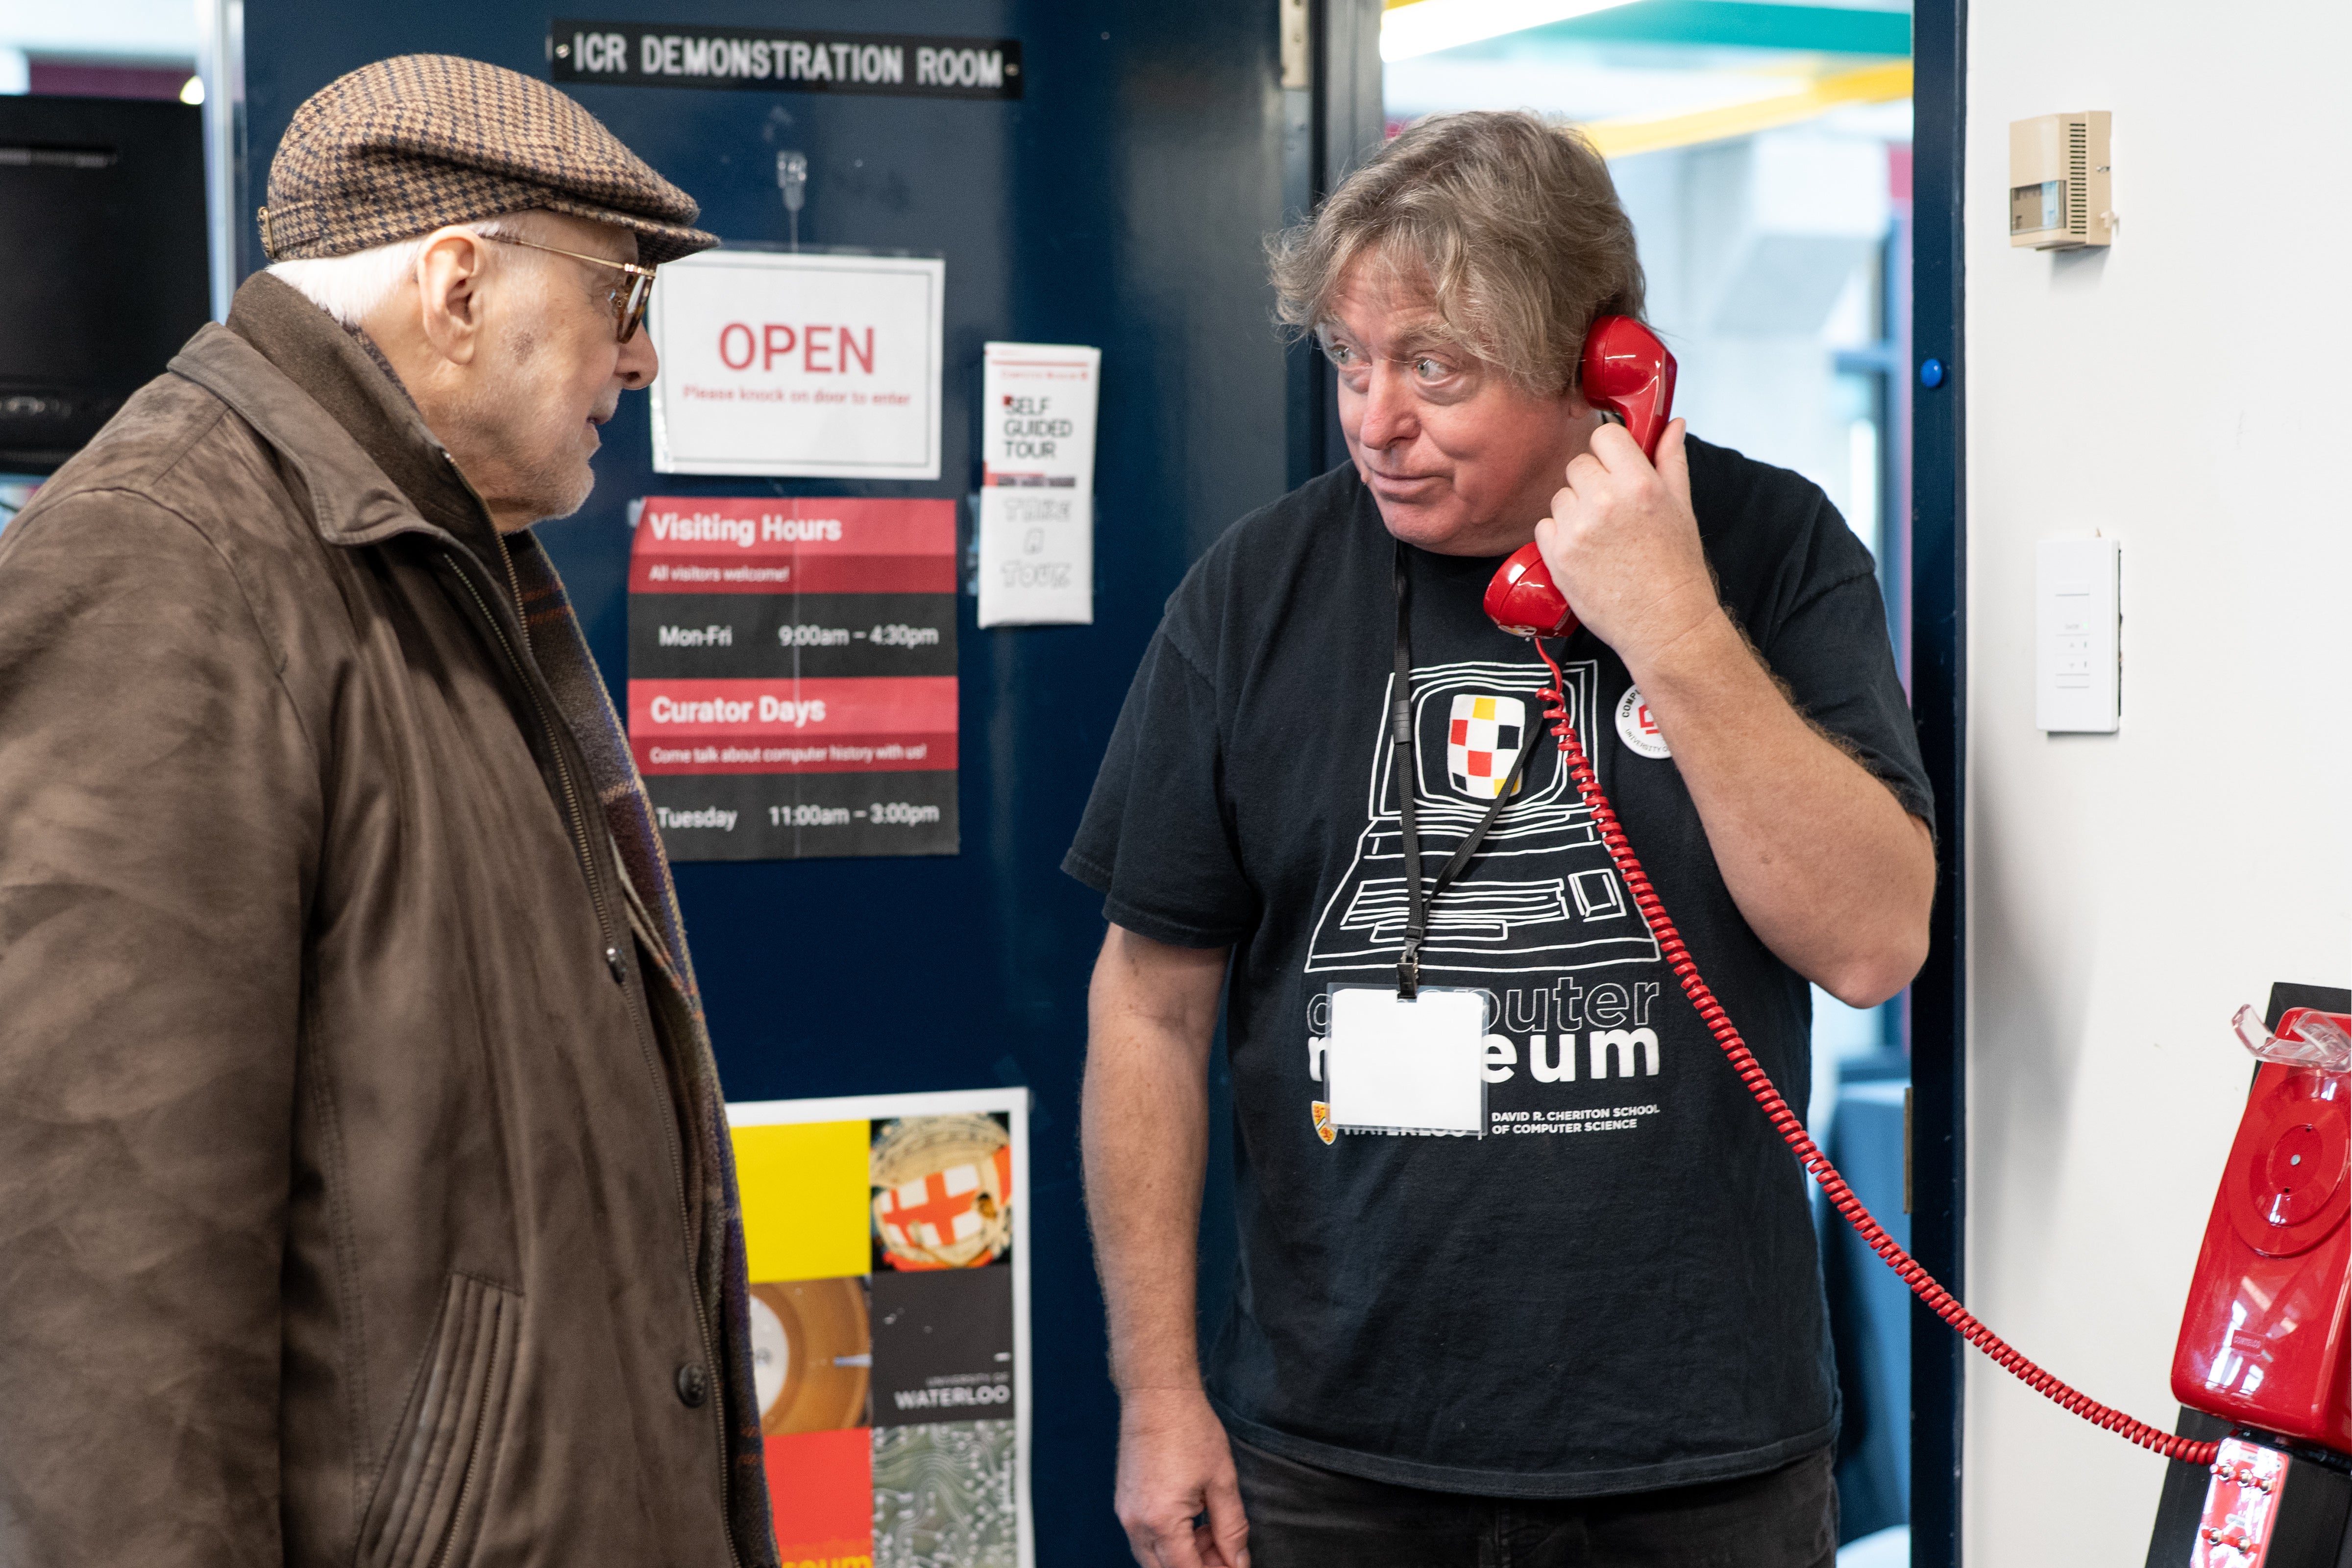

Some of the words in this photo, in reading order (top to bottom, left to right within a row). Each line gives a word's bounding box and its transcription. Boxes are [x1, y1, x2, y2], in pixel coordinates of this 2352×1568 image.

[574, 33, 627, 73] ICR
[641, 35, 903, 84] DEMONSTRATION
[917, 48, 1004, 87] ROOM
[719, 322, 875, 374] OPEN
[684, 385, 734, 402] Please
[739, 386, 784, 403] knock
[790, 392, 808, 403] on
[813, 389, 846, 404] door
[872, 393, 909, 406] enter
[1004, 396, 1051, 416] SELF
[1004, 419, 1072, 438] GUIDED
[1004, 442, 1056, 458] TOUR
[650, 513, 755, 547] Visiting
[762, 515, 842, 541] Hours
[649, 565, 669, 581] All
[670, 565, 721, 582] visitors
[723, 565, 789, 582] welcome!
[659, 625, 732, 646] Mon-Fri
[779, 625, 849, 646] 9:00am
[869, 625, 938, 649] 4:30pm
[651, 696, 753, 723] Curator
[760, 696, 826, 728] Days
[1625, 729, 1661, 752] UNIVERSITY
[649, 746, 691, 763] Come
[693, 746, 718, 763] talk
[721, 746, 760, 762] about
[762, 746, 827, 764] computer
[829, 745, 873, 764] history
[876, 744, 904, 760] with
[656, 807, 737, 832] Tuesday
[769, 805, 849, 826] 11:00am
[869, 804, 940, 827] 3:00pm
[1492, 1112, 1529, 1122] DAVID
[1533, 1111, 1545, 1121] R.
[1546, 1108, 1610, 1121] CHERITON
[1613, 1104, 1660, 1117] SCHOOL
[1492, 1125, 1510, 1134] OF
[1513, 1123, 1582, 1133] COMPUTER
[1584, 1119, 1637, 1131] SCIENCE
[894, 1385, 1010, 1409] WATERLOO
